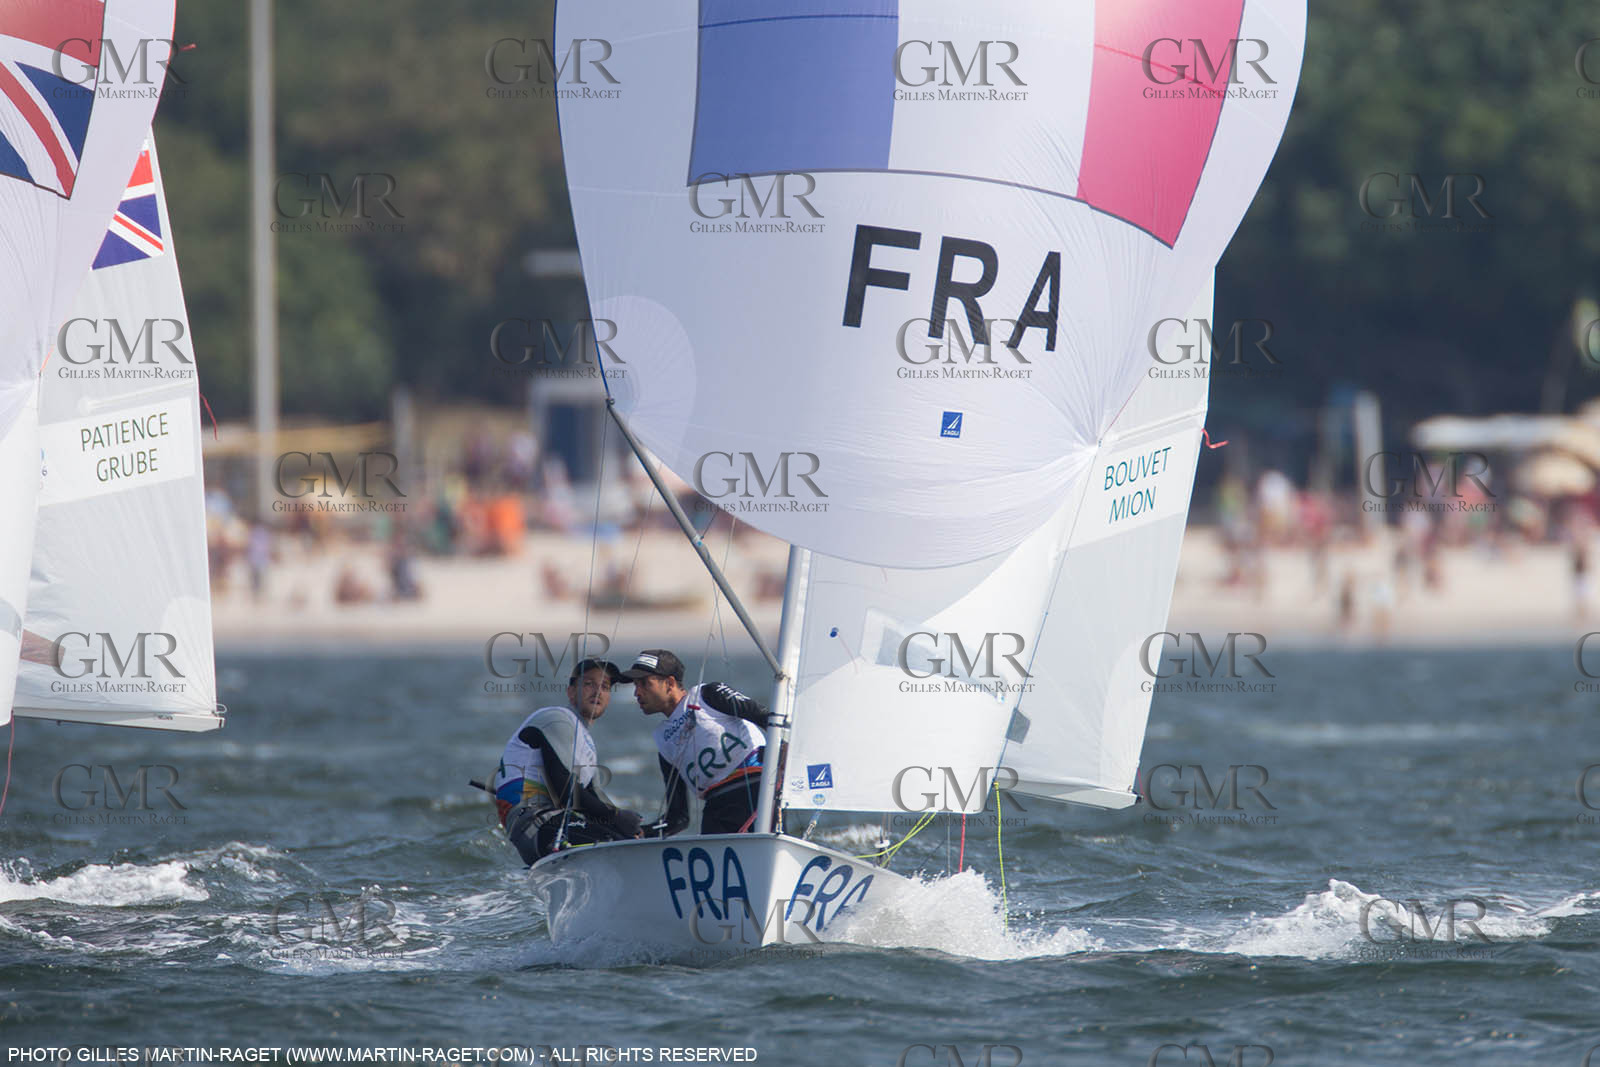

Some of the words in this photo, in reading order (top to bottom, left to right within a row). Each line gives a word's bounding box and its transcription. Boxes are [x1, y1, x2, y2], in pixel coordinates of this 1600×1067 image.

[842, 224, 1061, 352] FRA
[80, 412, 169, 452] PATIENCE
[96, 448, 158, 482] GRUBE
[1104, 446, 1172, 491] BOUVET
[1108, 485, 1157, 525] MION
[686, 732, 748, 790] FRA
[662, 846, 751, 921] FRA
[784, 855, 875, 933] FRA
